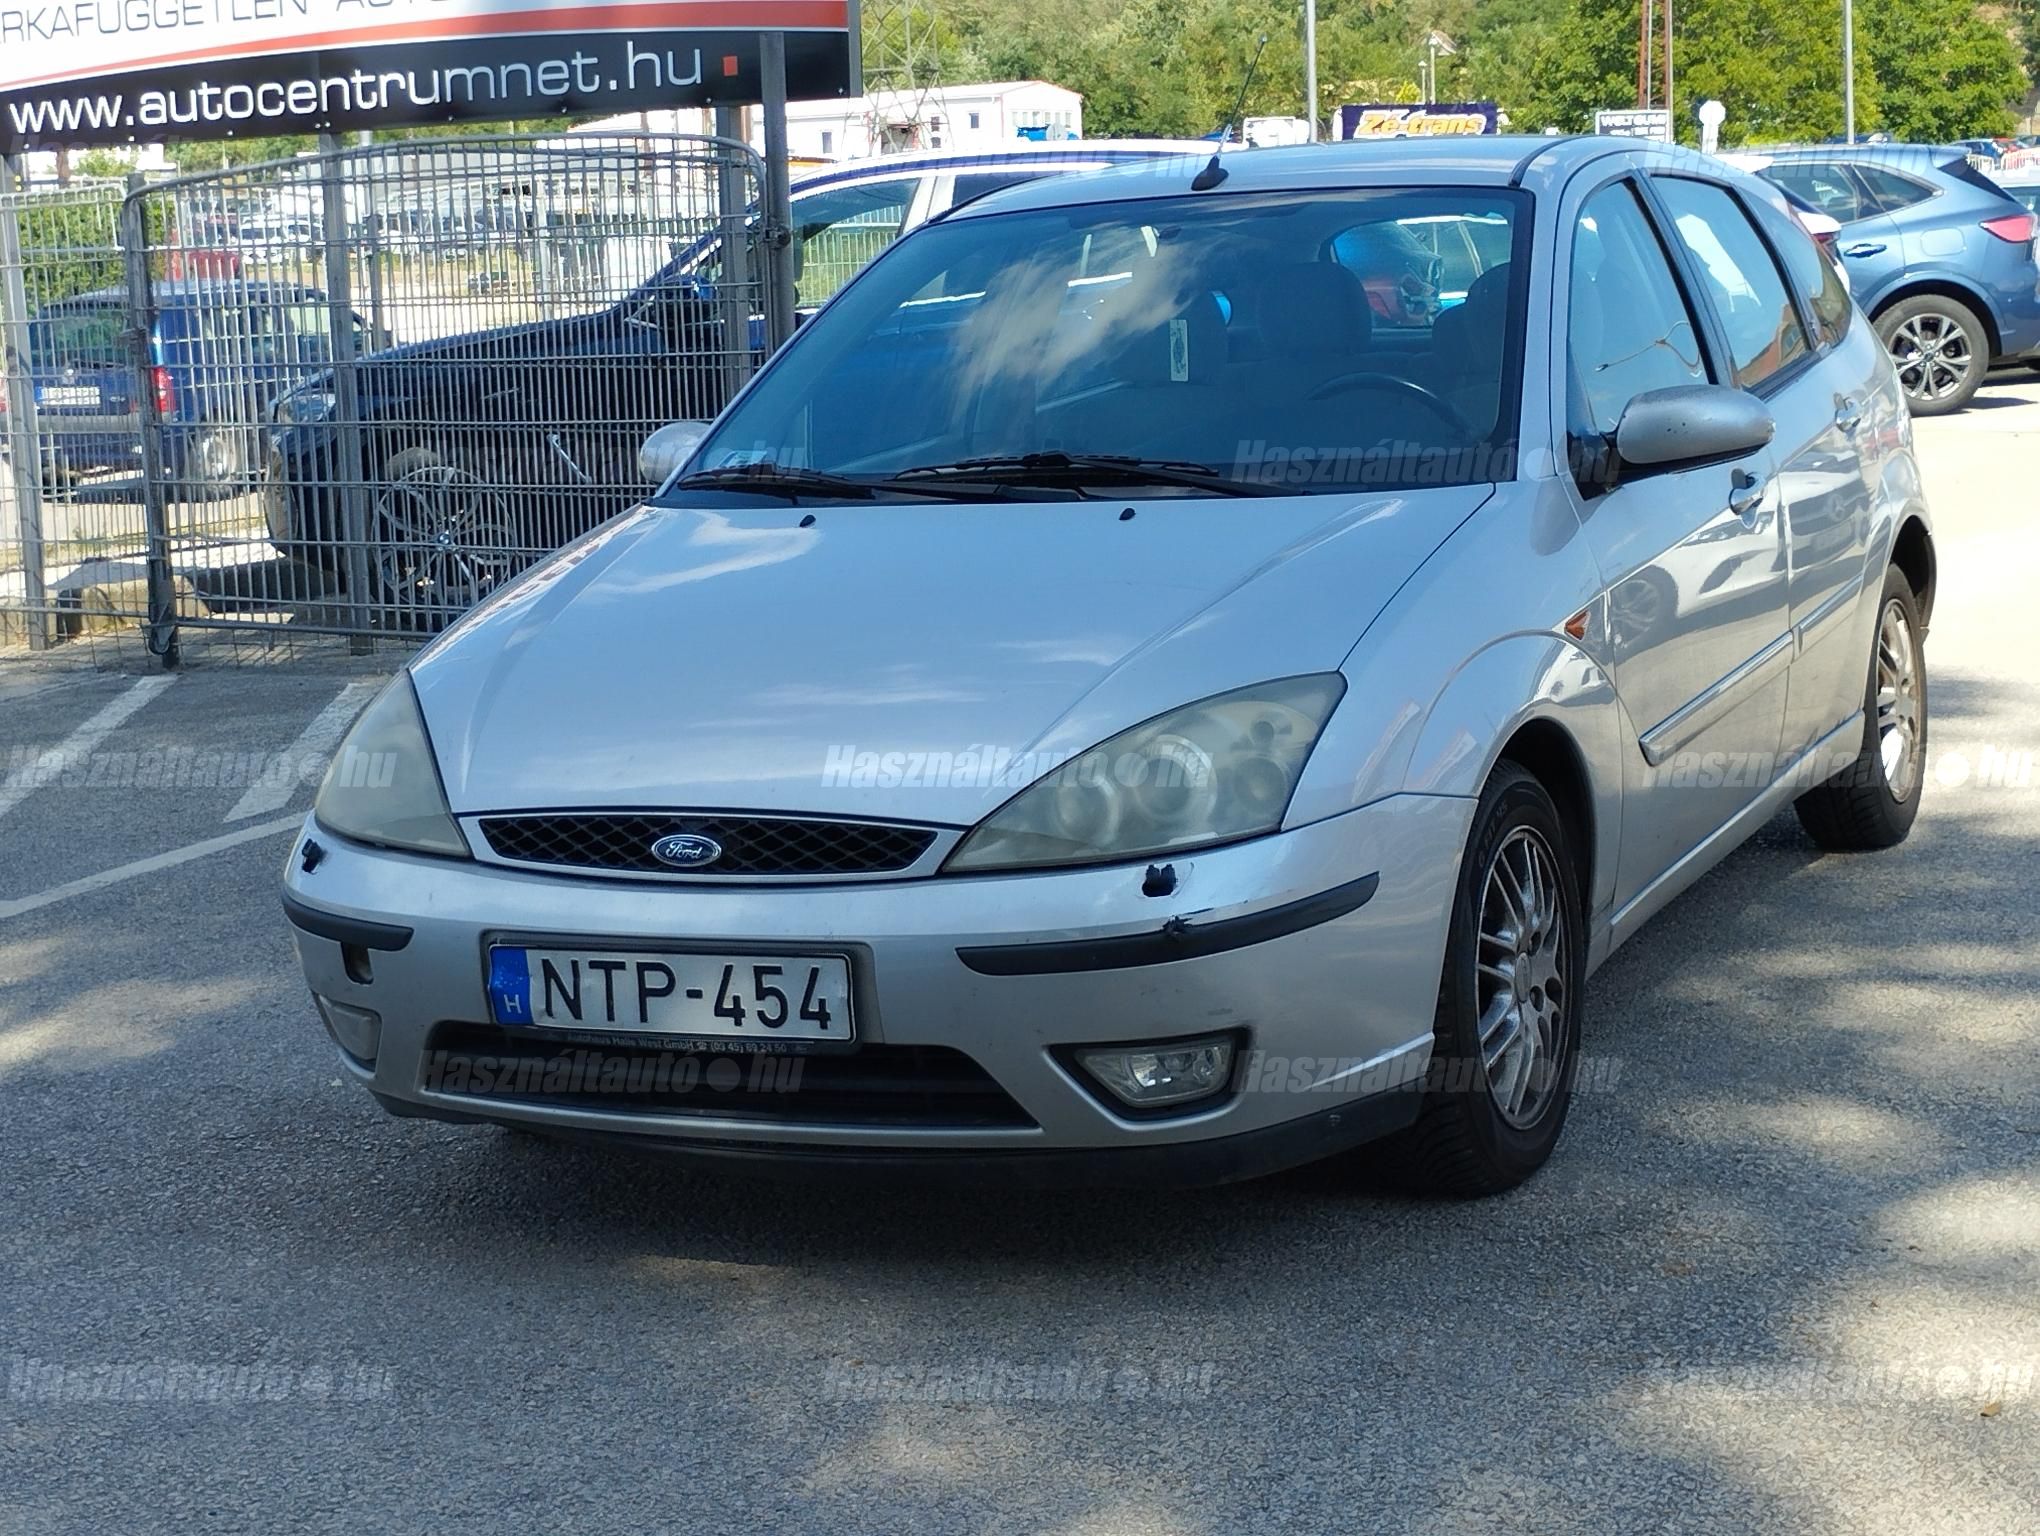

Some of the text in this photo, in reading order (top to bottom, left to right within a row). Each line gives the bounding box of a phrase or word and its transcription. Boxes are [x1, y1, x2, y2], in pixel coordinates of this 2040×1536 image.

[9, 40, 702, 134] www.autocentrumnet.hu
[665, 840, 704, 859] Ford
[504, 994, 522, 1015] H
[540, 957, 833, 1031] NTP-454
[663, 1038, 694, 1050] GmbH
